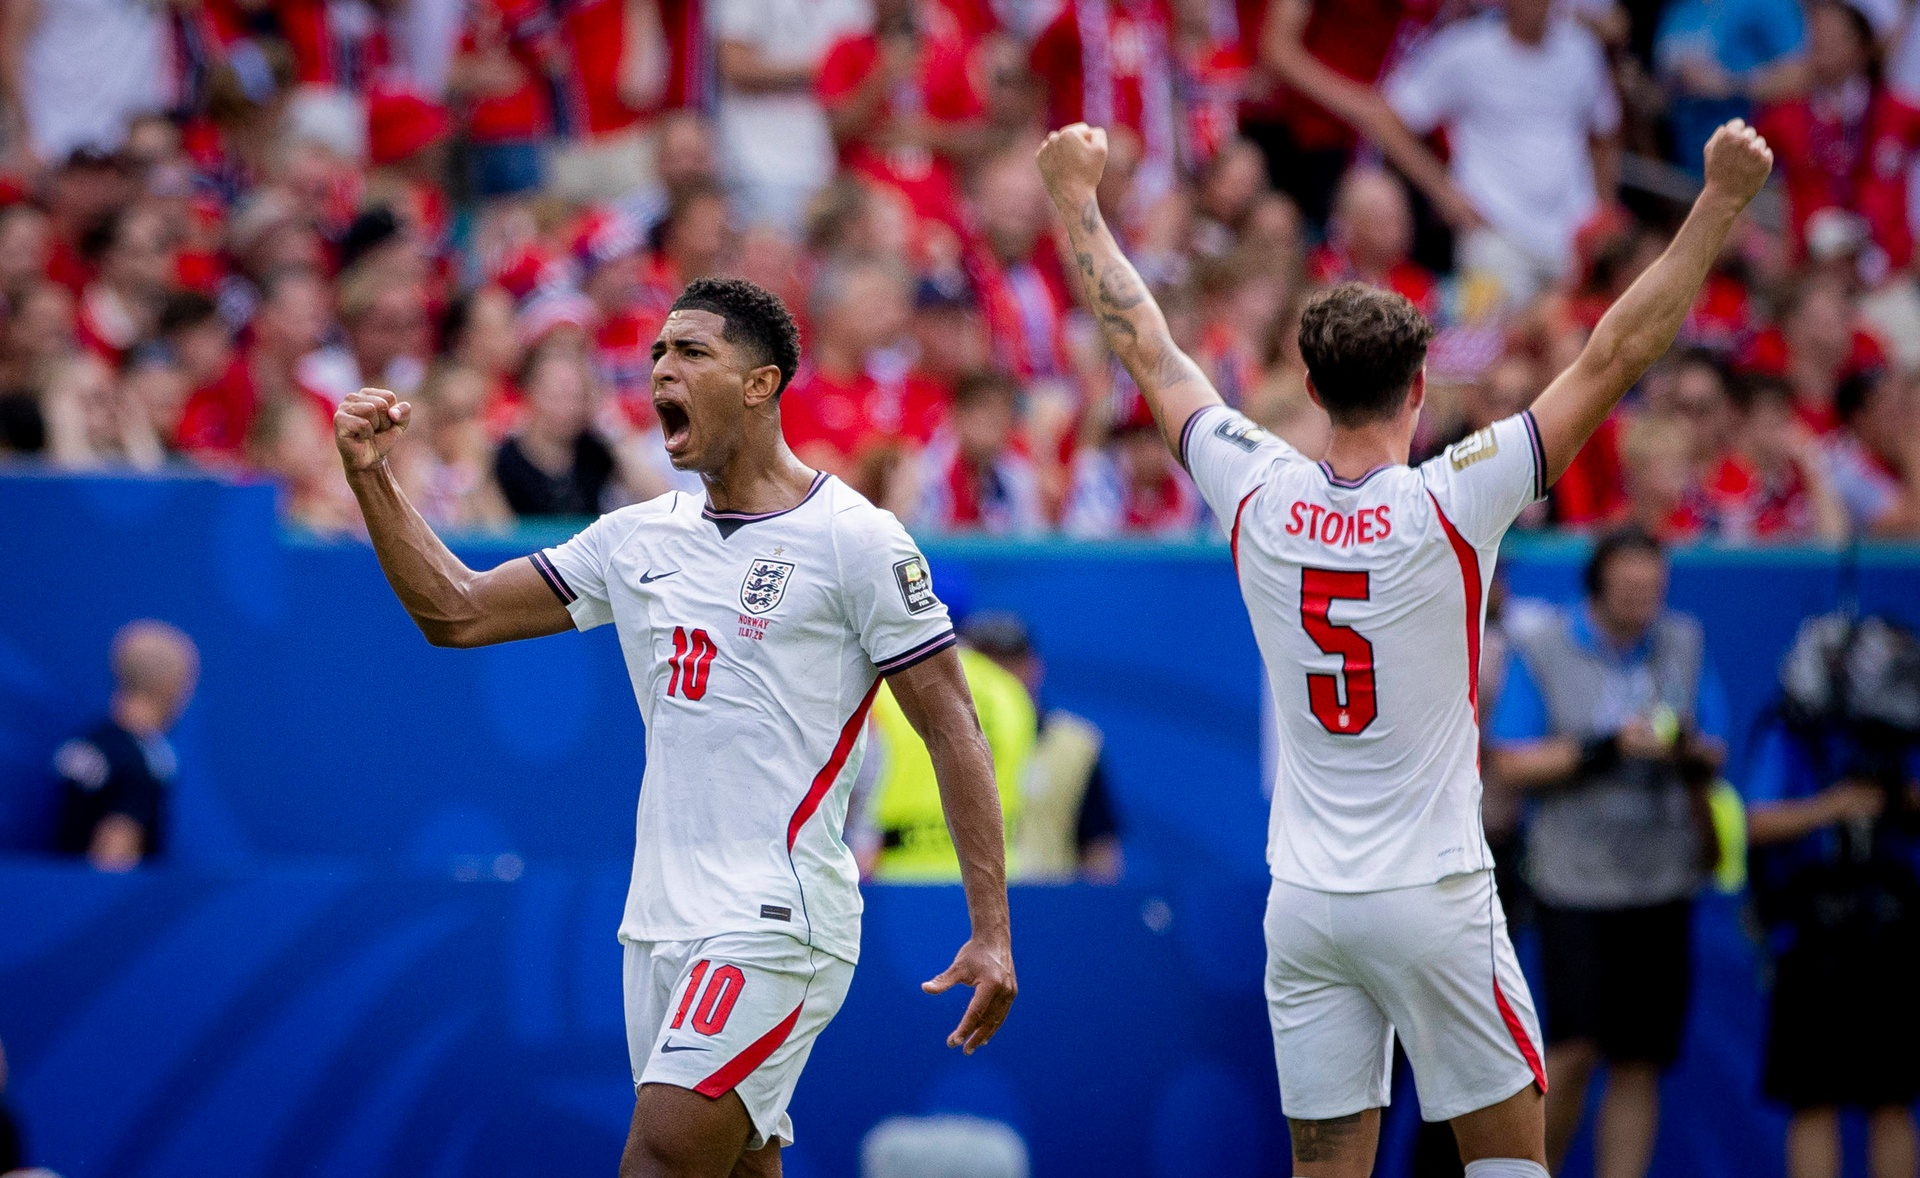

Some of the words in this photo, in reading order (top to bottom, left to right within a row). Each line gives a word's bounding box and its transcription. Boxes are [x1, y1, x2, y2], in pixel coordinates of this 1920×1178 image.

[738, 614, 769, 630] NORWAY
[1300, 567, 1378, 735] 5
[667, 626, 718, 702] 10
[669, 959, 746, 1037] 10
